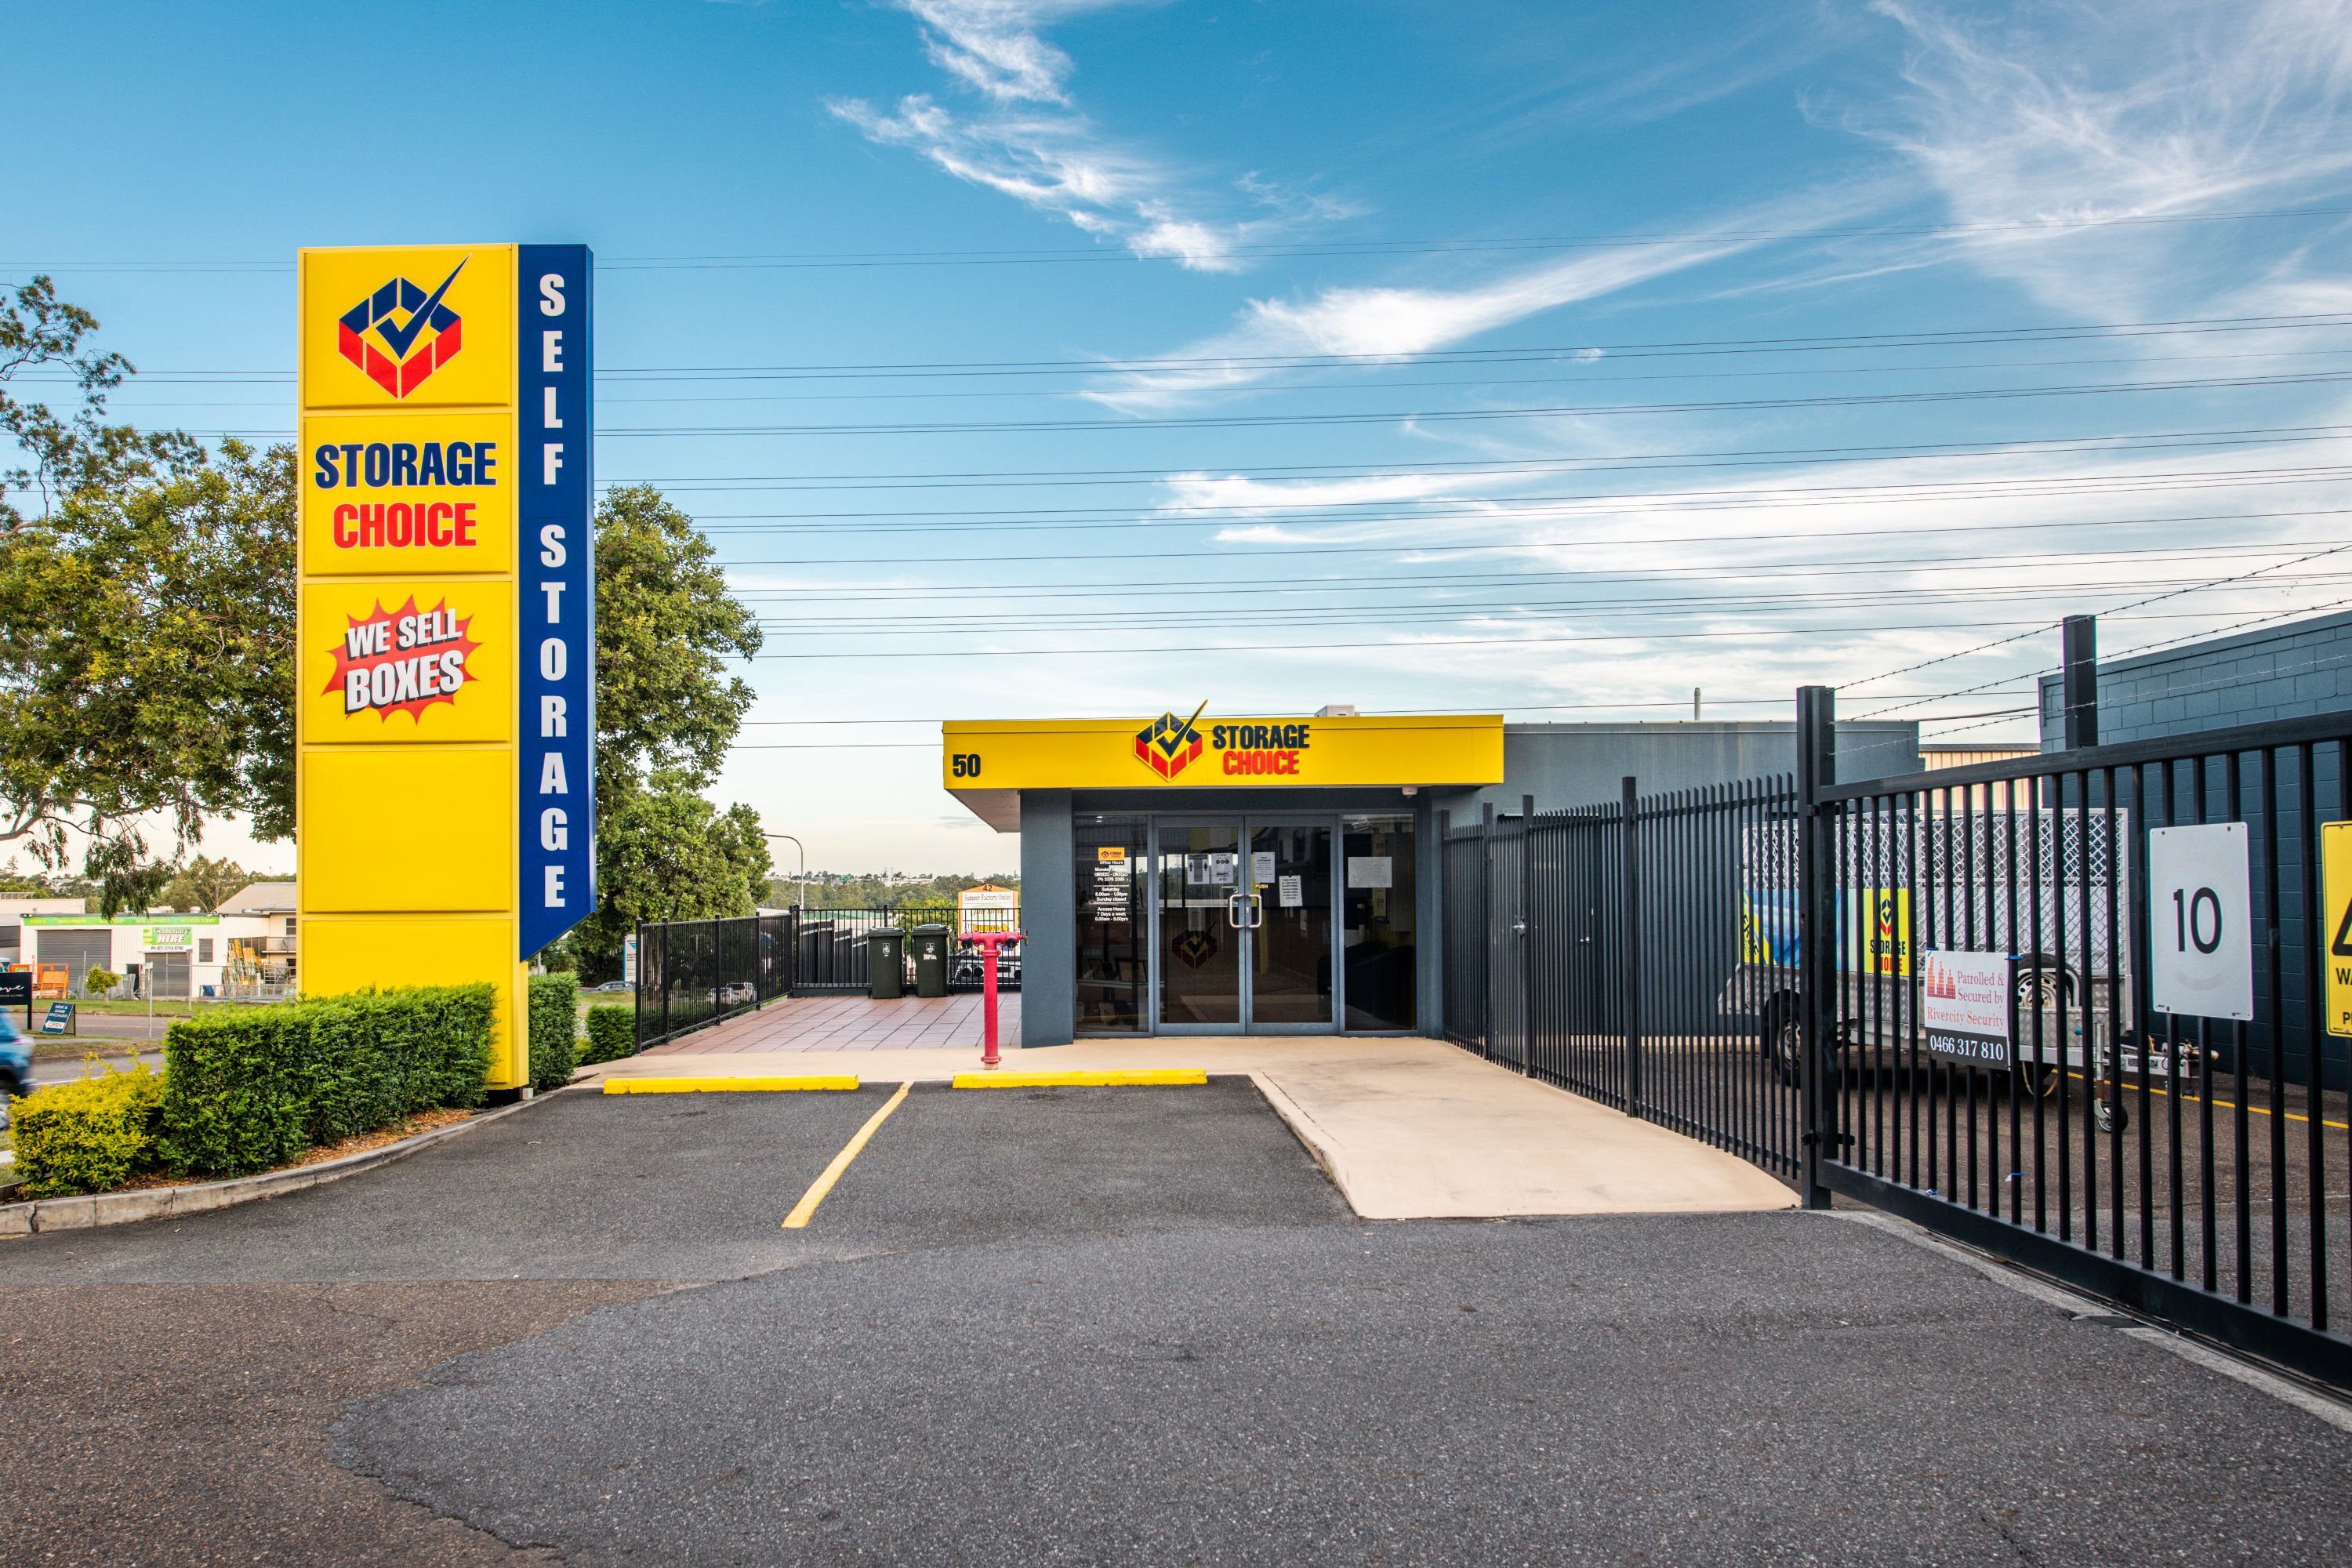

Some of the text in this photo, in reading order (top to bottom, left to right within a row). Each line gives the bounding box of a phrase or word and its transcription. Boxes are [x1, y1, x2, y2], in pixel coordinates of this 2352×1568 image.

[539, 273, 566, 485] SELF
[314, 441, 497, 489] STORAGE
[333, 502, 477, 550] CHOICE
[345, 608, 463, 661] WE SELL
[344, 649, 464, 715] BOXES
[539, 524, 568, 908] STORAGE
[1212, 724, 1310, 750] STORAGE
[952, 753, 982, 778] 50
[1223, 750, 1300, 775] CHOICE
[2172, 887, 2223, 954] 10
[157, 934, 186, 944] HIRE
[1957, 971, 2005, 986] Patrolled &
[1958, 988, 2005, 1008] Secured by
[1926, 1006, 2005, 1030] Rivercity Security
[1929, 1034, 2004, 1061] 0466 317 810
